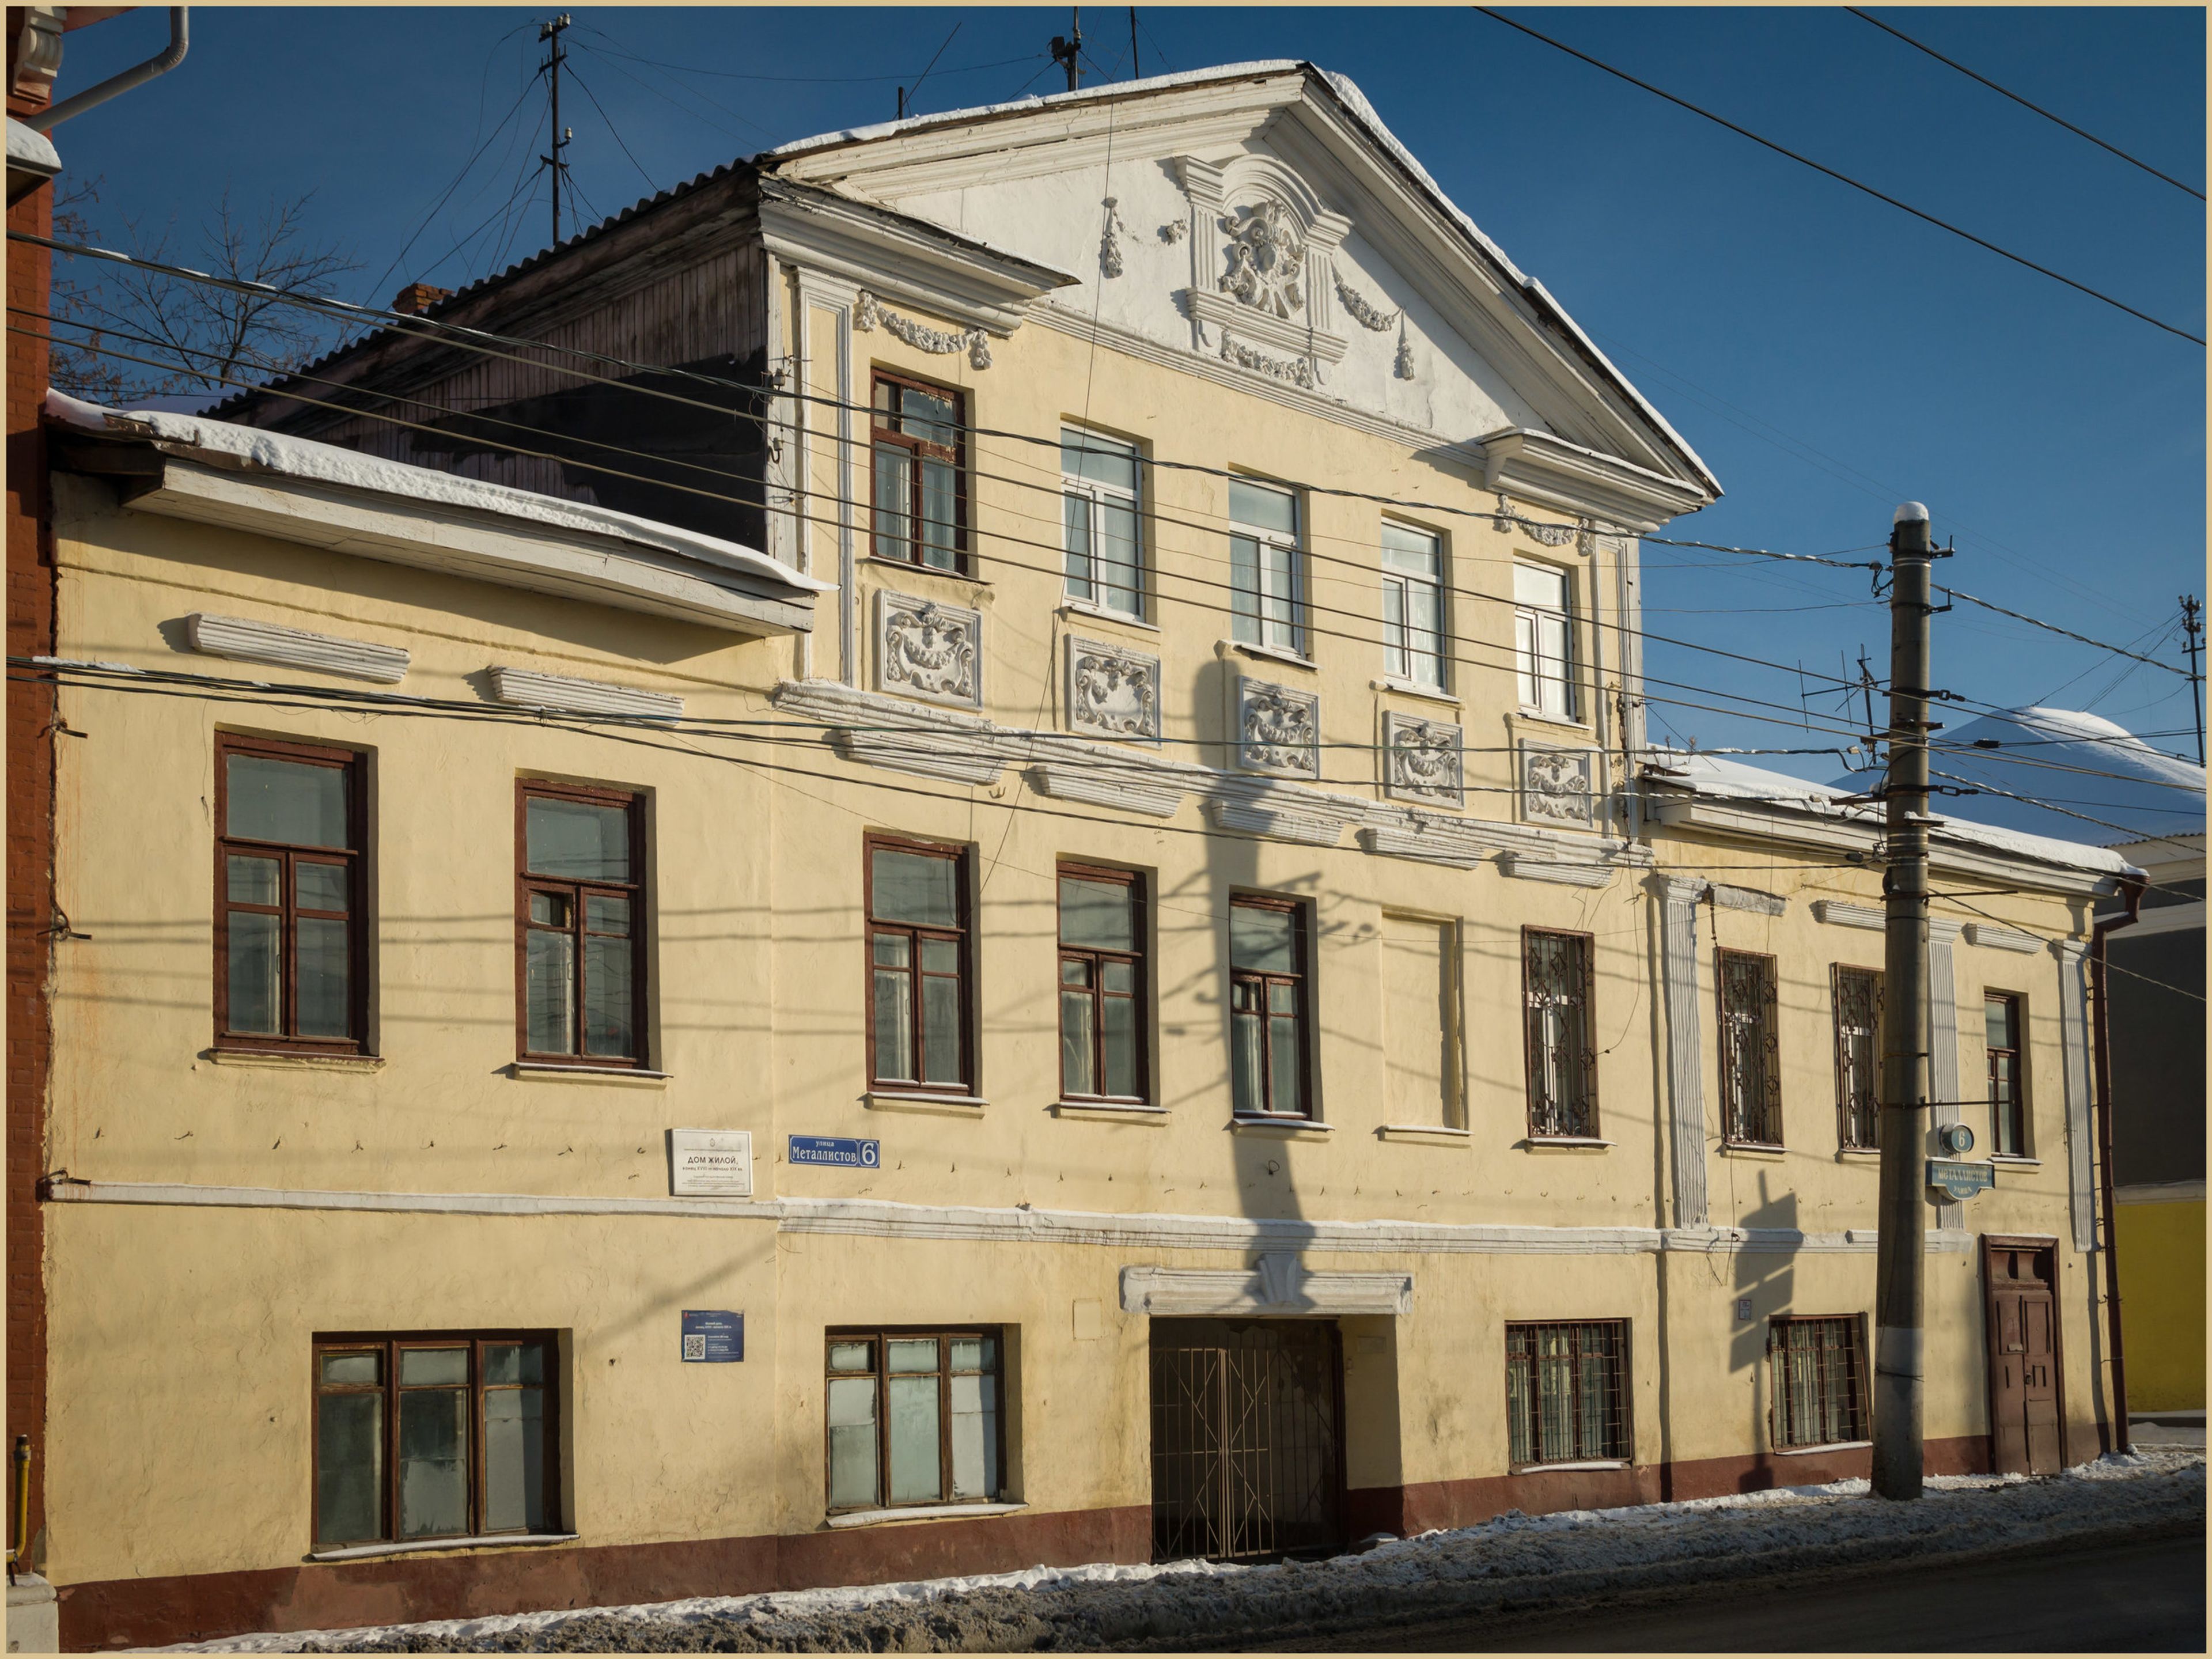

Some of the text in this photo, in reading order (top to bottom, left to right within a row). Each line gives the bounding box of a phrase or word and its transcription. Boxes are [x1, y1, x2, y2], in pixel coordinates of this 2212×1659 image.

[1959, 1131, 1966, 1147] 6
[708, 1156, 738, 1165] ЖИЛОЙ,
[792, 1146, 857, 1162] Металлистов
[862, 1142, 876, 1165] 6
